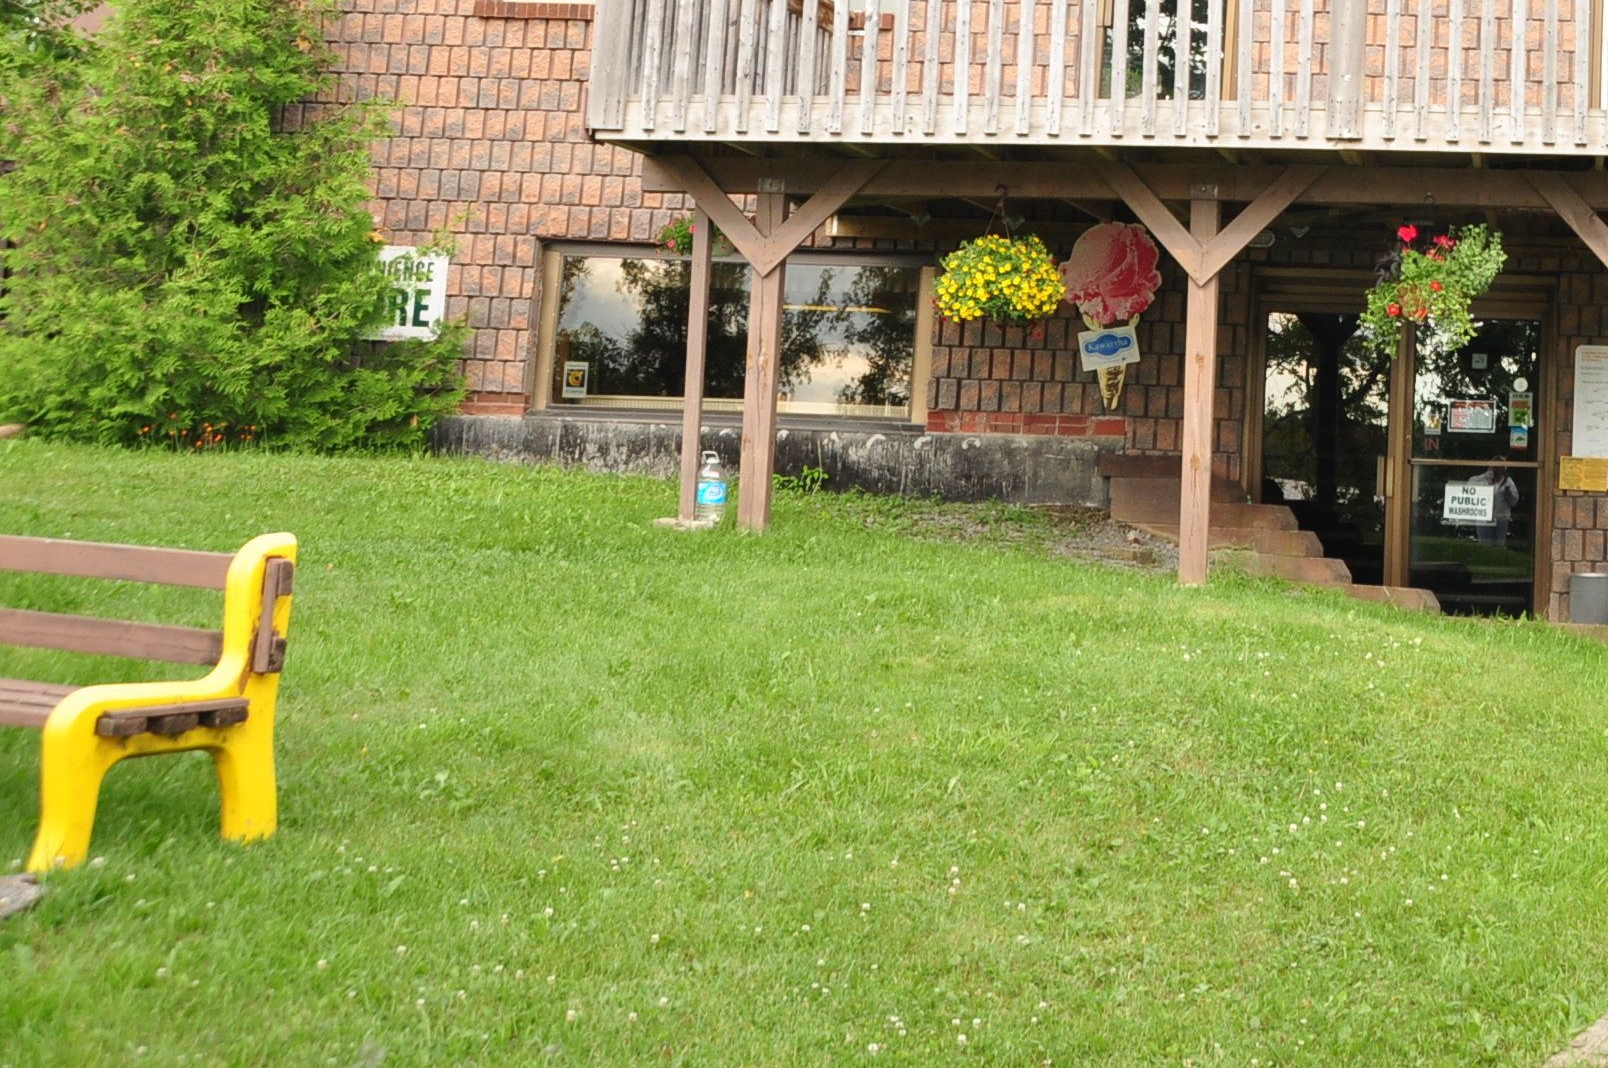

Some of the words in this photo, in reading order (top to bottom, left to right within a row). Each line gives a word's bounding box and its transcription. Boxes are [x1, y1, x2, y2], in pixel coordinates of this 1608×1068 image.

[1462, 486, 1477, 496] NO
[1451, 496, 1487, 507] PUBLIC
[1448, 507, 1487, 517] WASHROOMS
